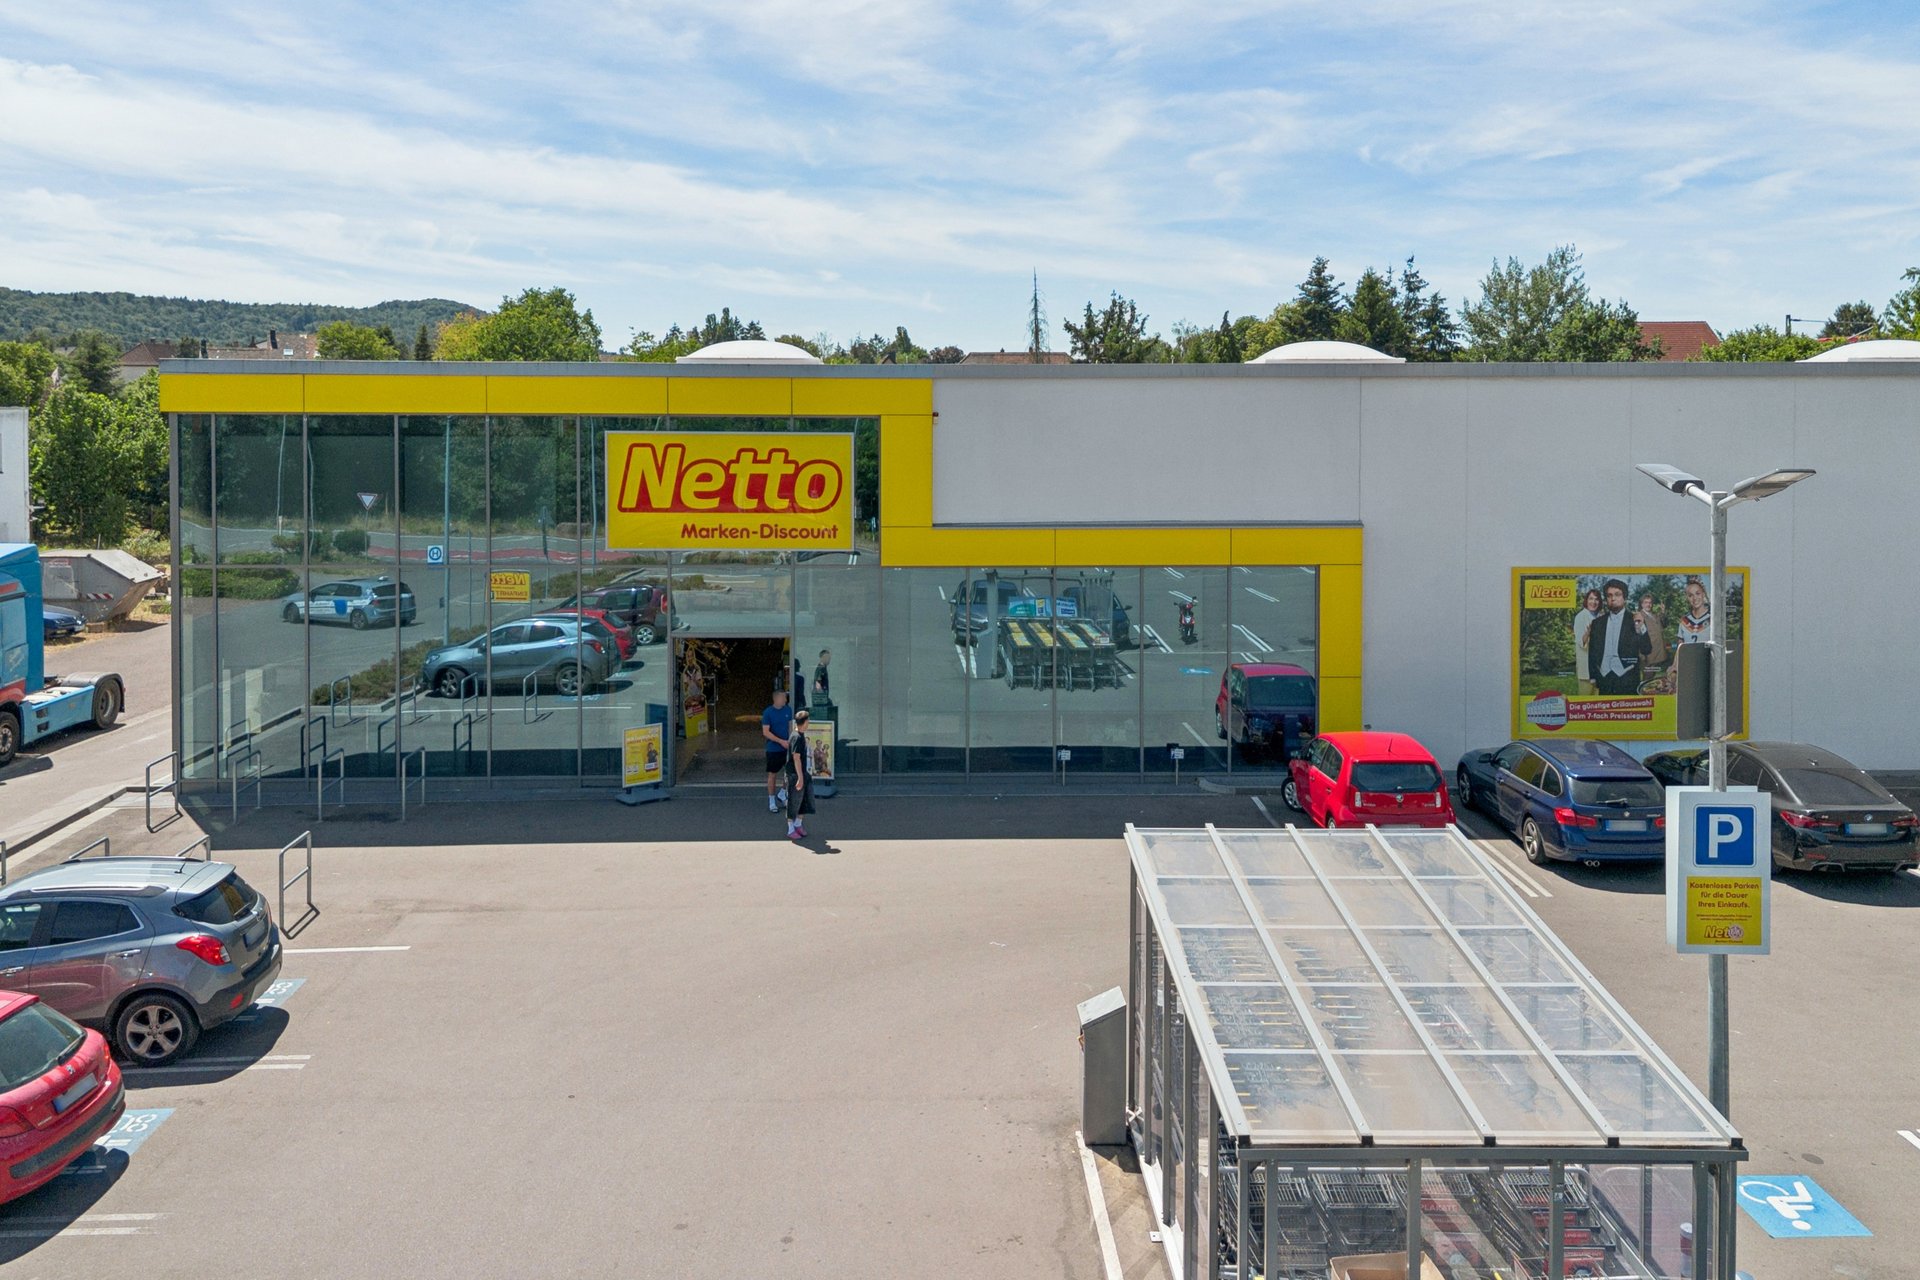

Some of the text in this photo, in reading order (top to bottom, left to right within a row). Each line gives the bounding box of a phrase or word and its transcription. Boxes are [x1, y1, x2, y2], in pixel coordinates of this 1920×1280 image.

[617, 443, 843, 513] Netto
[681, 523, 839, 539] Marken-Discount
[1531, 585, 1570, 598] Netto
[1582, 701, 1610, 711] günstige
[1611, 699, 1652, 707] Grillauswahl
[1610, 712, 1651, 720] Preissieger!
[1709, 814, 1742, 858] P
[1717, 901, 1750, 909] Einkaufs.
